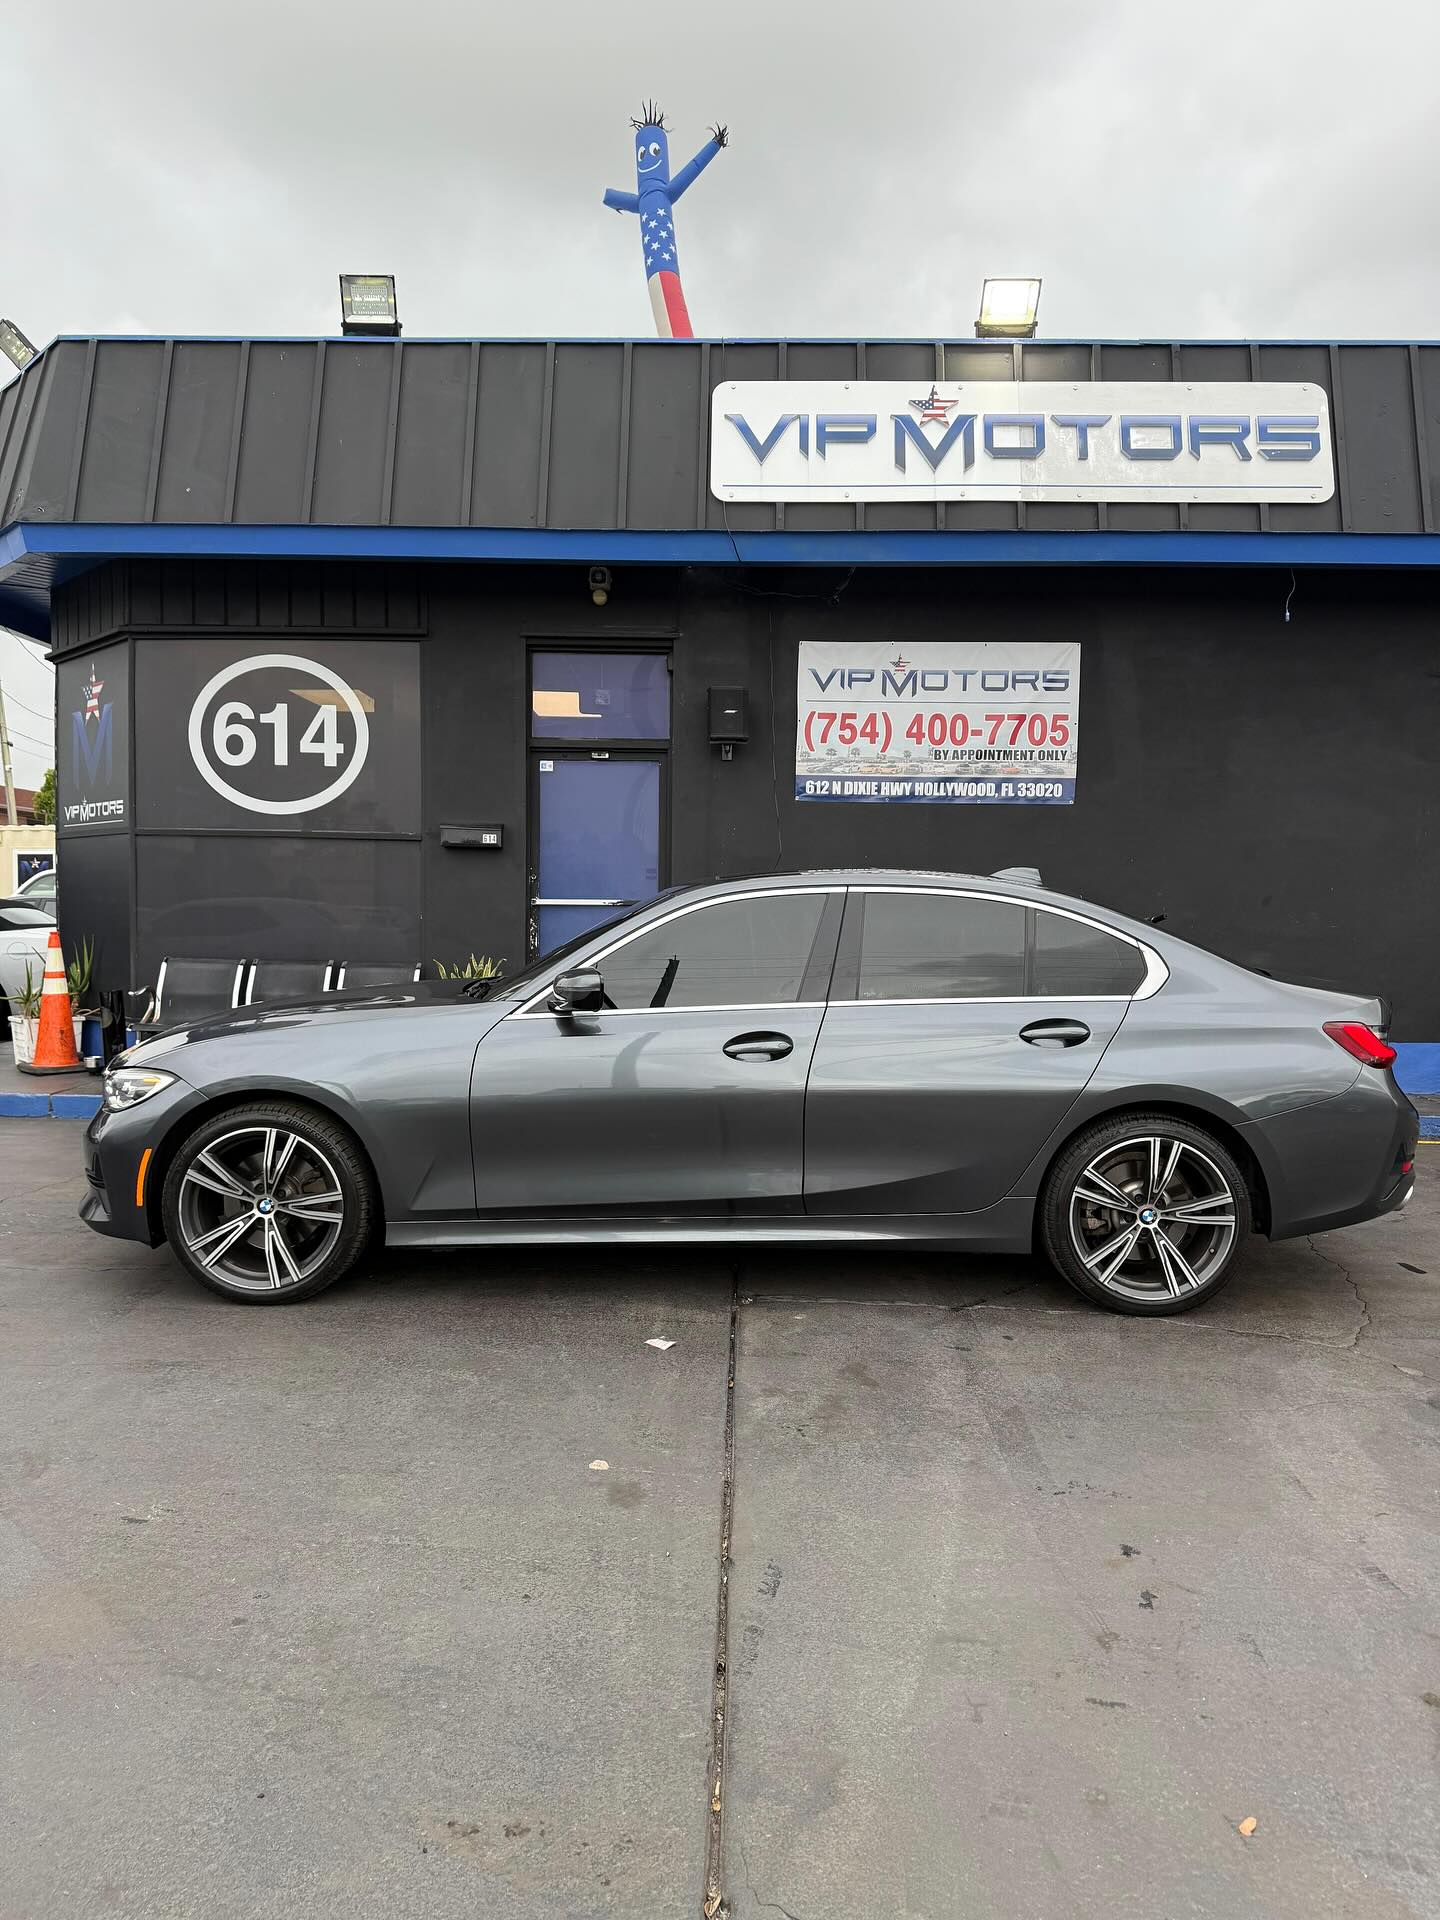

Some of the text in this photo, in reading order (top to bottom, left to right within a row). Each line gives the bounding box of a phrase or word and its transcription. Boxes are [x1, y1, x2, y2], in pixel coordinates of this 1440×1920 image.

[724, 413, 1321, 475] VIP MOTORS
[807, 668, 1070, 698] VIP MOTORS
[212, 701, 344, 767] 614
[804, 710, 1070, 754] (754) 400-7705
[934, 749, 1067, 761] BY APPOINTMENT ONLY
[805, 780, 1063, 798] 612 N DIXIE HWY HOLLYWOOD, FL 33020
[64, 799, 124, 823] VIP MOTORS
